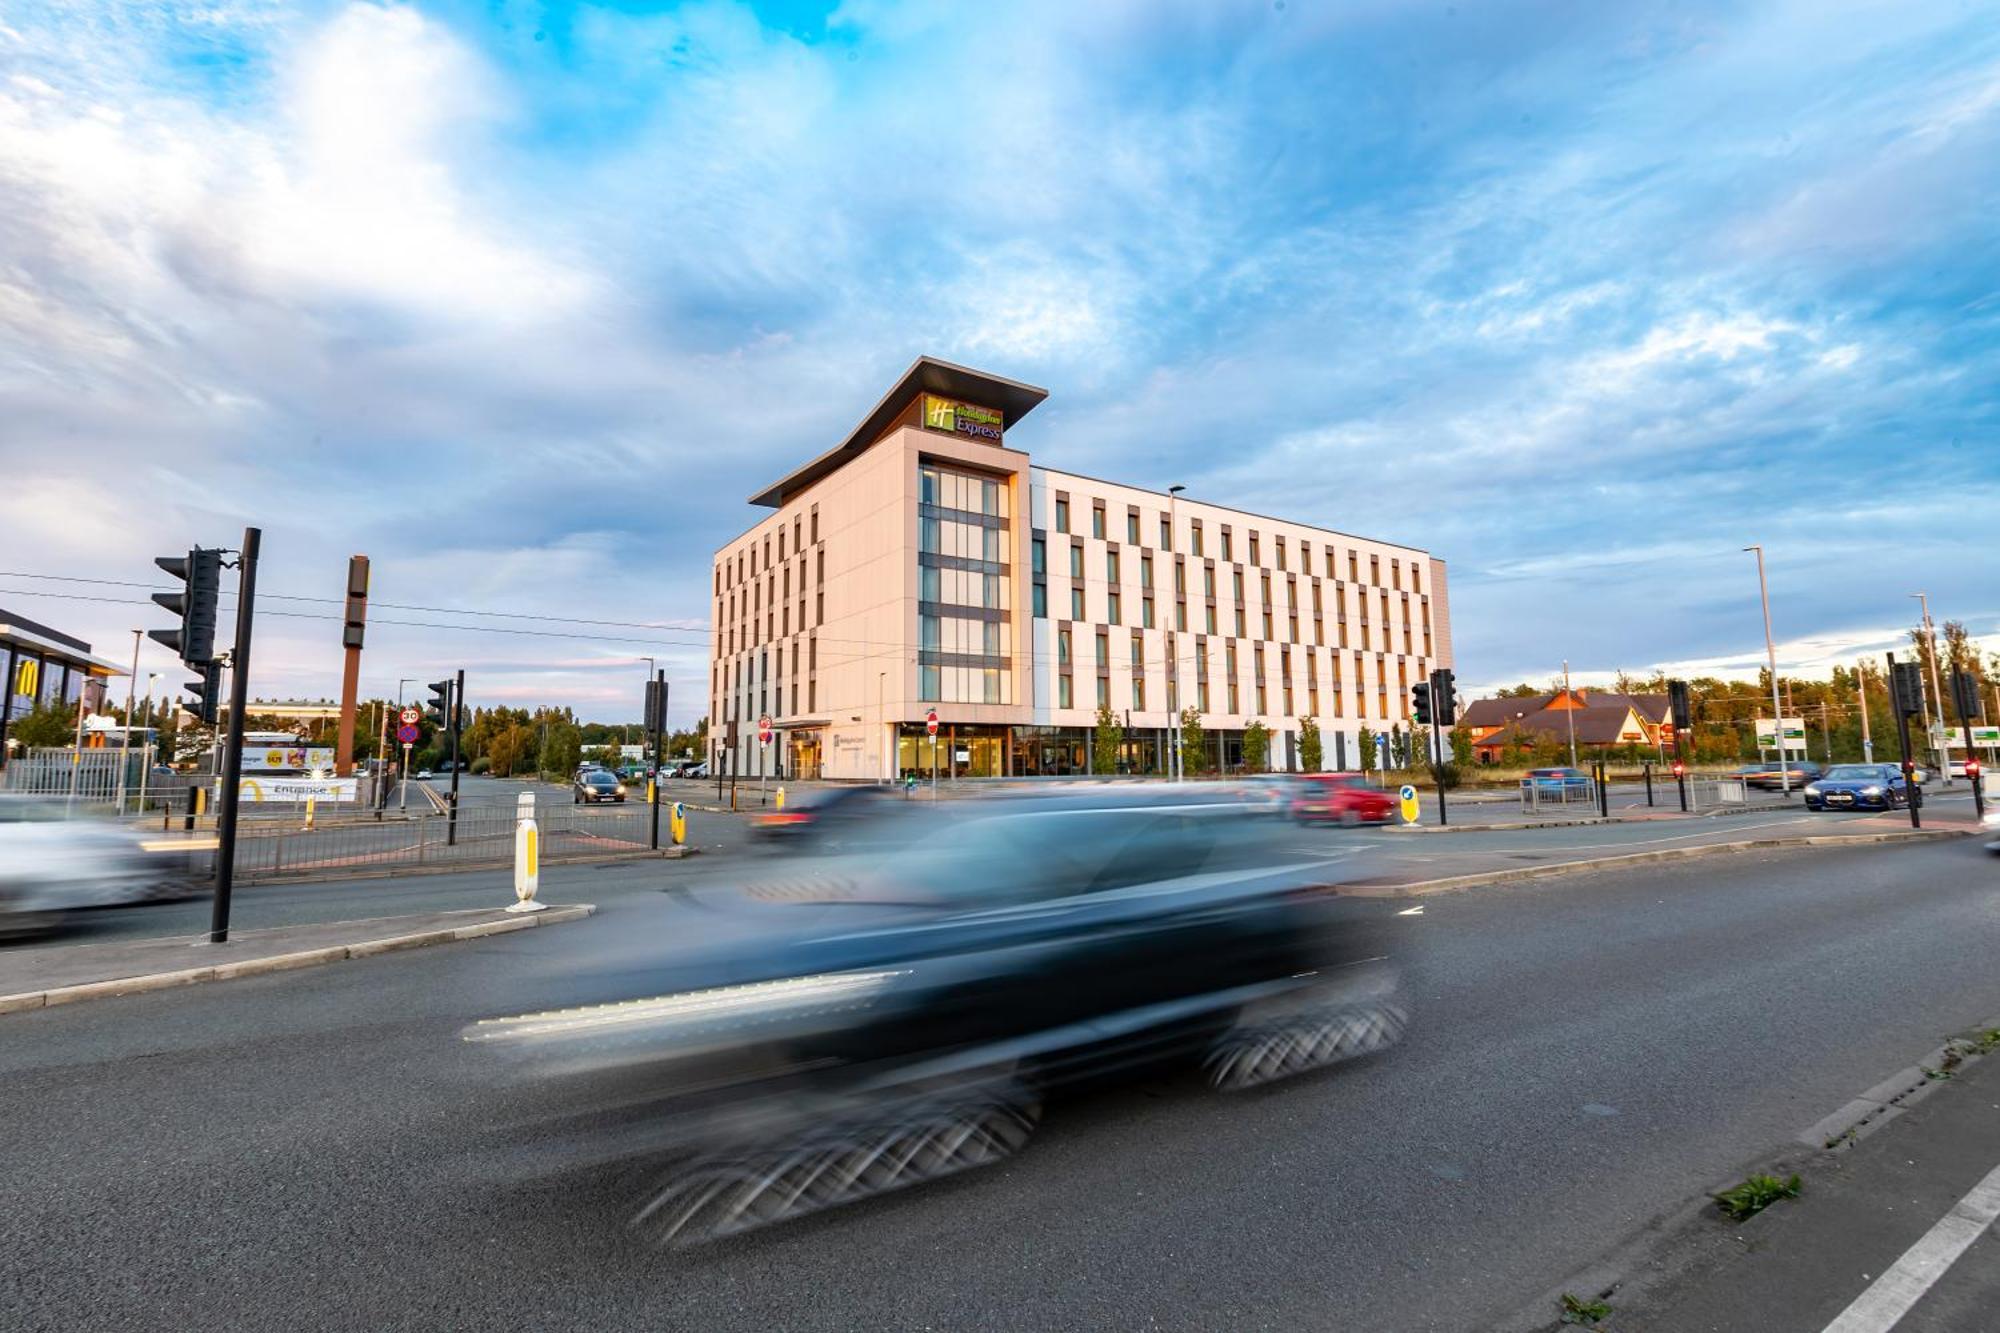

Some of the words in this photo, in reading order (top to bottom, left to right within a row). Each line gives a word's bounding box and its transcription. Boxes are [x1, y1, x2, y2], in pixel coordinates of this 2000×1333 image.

[957, 406, 987, 424] Holiday
[988, 412, 1001, 425] Inn
[957, 417, 1000, 440] Express
[403, 712, 417, 720] 30
[274, 785, 327, 794] Entrance
